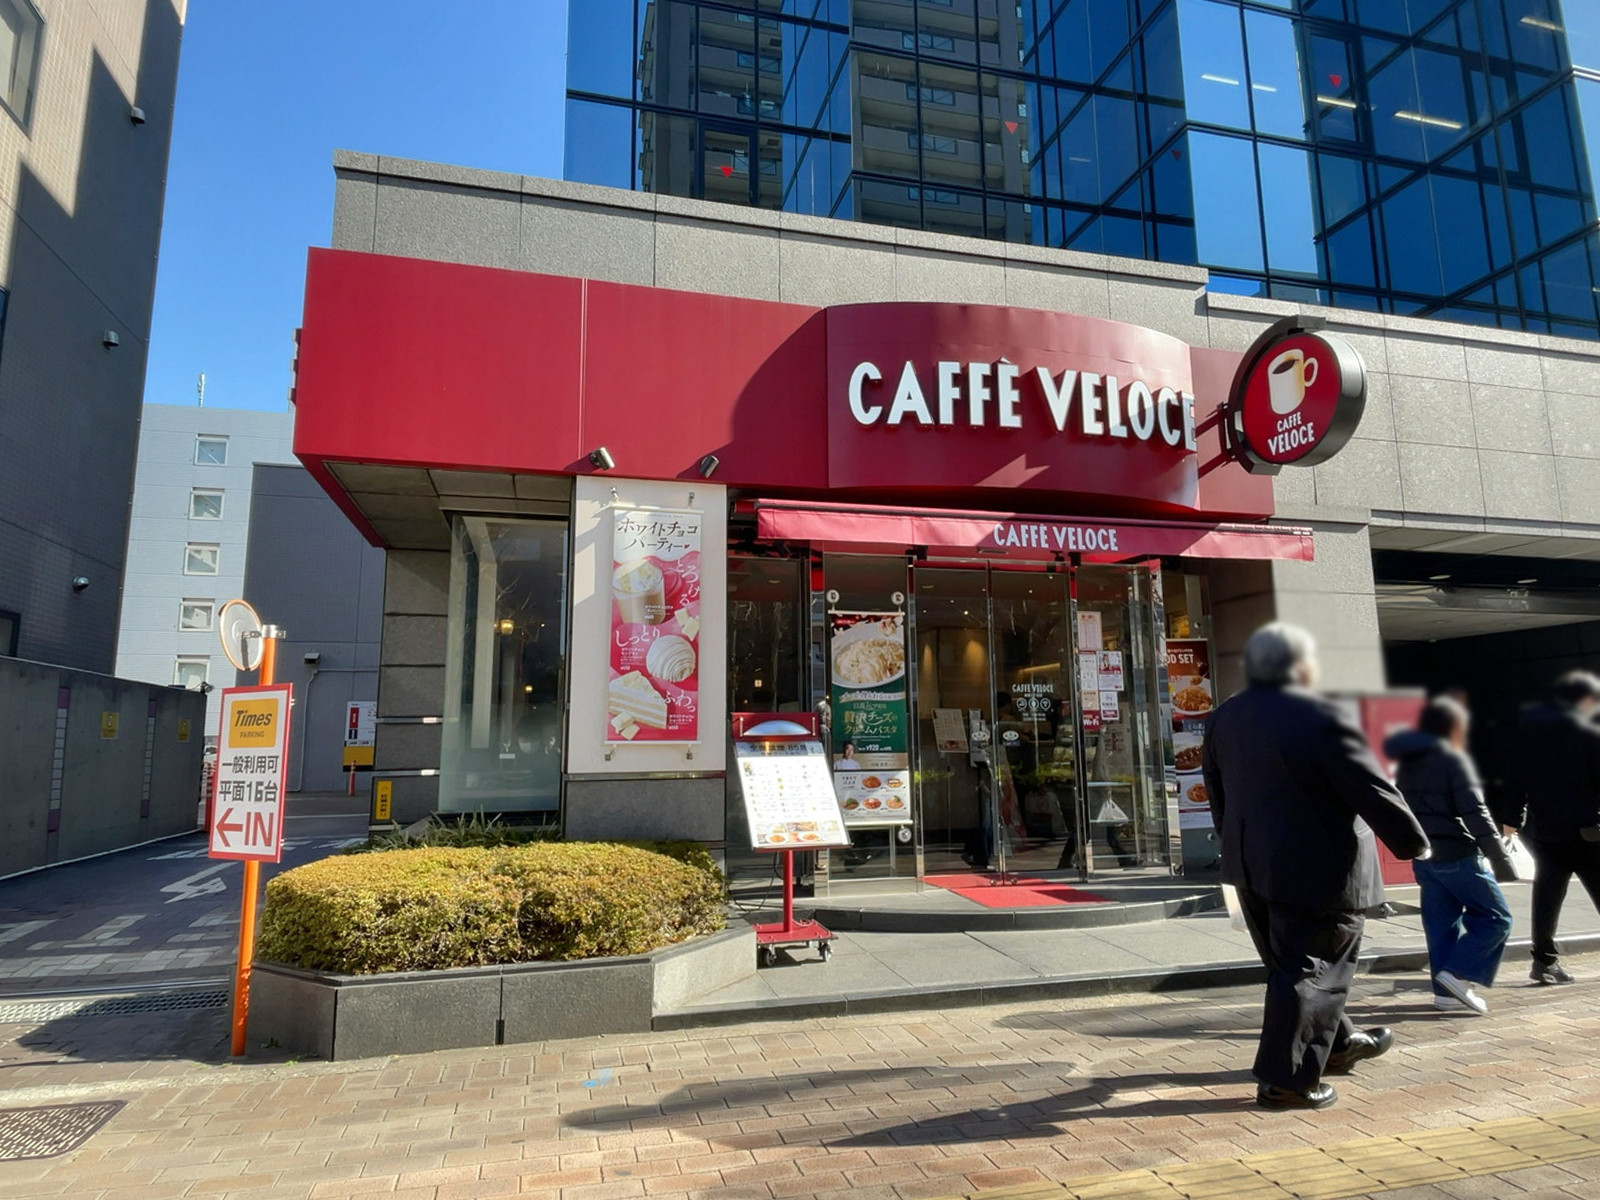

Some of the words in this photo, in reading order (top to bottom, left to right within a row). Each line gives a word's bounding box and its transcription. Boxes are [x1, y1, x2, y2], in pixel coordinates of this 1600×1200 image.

[1036, 366, 1197, 451] VELOCE
[1267, 422, 1315, 456] VELOCE
[617, 518, 698, 537] ホワイトチョコ
[1052, 526, 1118, 551] VELOCE
[615, 625, 660, 647] しっとり
[1178, 653, 1194, 664] SET
[664, 689, 696, 713] ふわっ
[234, 710, 273, 727] Times
[240, 730, 265, 738] PARKING
[222, 755, 279, 775] 一般利用可
[219, 780, 278, 803] 平面16台
[244, 811, 274, 848] IN
